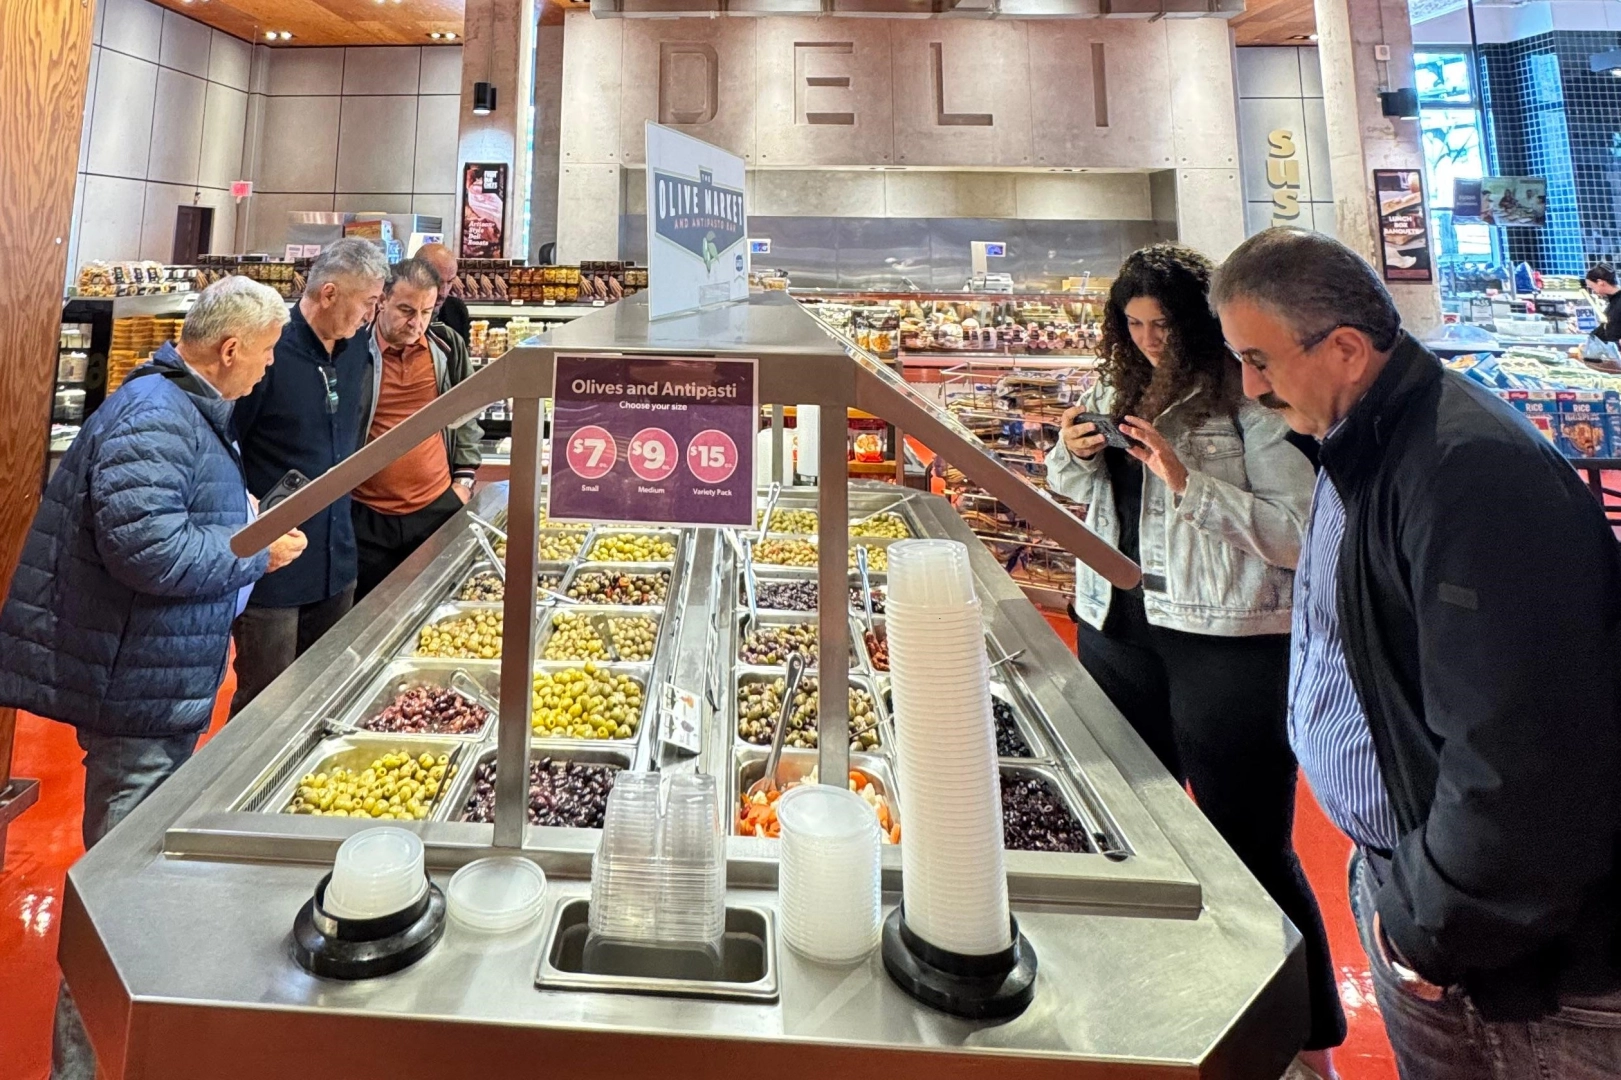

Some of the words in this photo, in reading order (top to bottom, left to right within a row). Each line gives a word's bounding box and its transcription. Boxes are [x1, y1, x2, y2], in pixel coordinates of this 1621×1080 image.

[658, 41, 1110, 127] DELI
[701, 173, 711, 183] THE
[1266, 129, 1300, 227] sus
[658, 179, 699, 219] OLIVE
[704, 188, 743, 226] MARKET
[674, 217, 689, 230] AND
[692, 217, 724, 231] ANTIPASTO
[1576, 308, 1595, 317] OPEN
[571, 379, 624, 395] Olives
[626, 381, 658, 396] and
[661, 381, 737, 400] Antipasti
[619, 401, 650, 410] Choose
[651, 402, 670, 411] your
[671, 402, 688, 411] size
[573, 438, 607, 468] $7
[632, 440, 666, 470] $9
[690, 445, 726, 468] $15
[581, 484, 600, 492] Small
[637, 486, 665, 494] Medium
[692, 487, 716, 497] Variety
[716, 488, 733, 497] Pack
